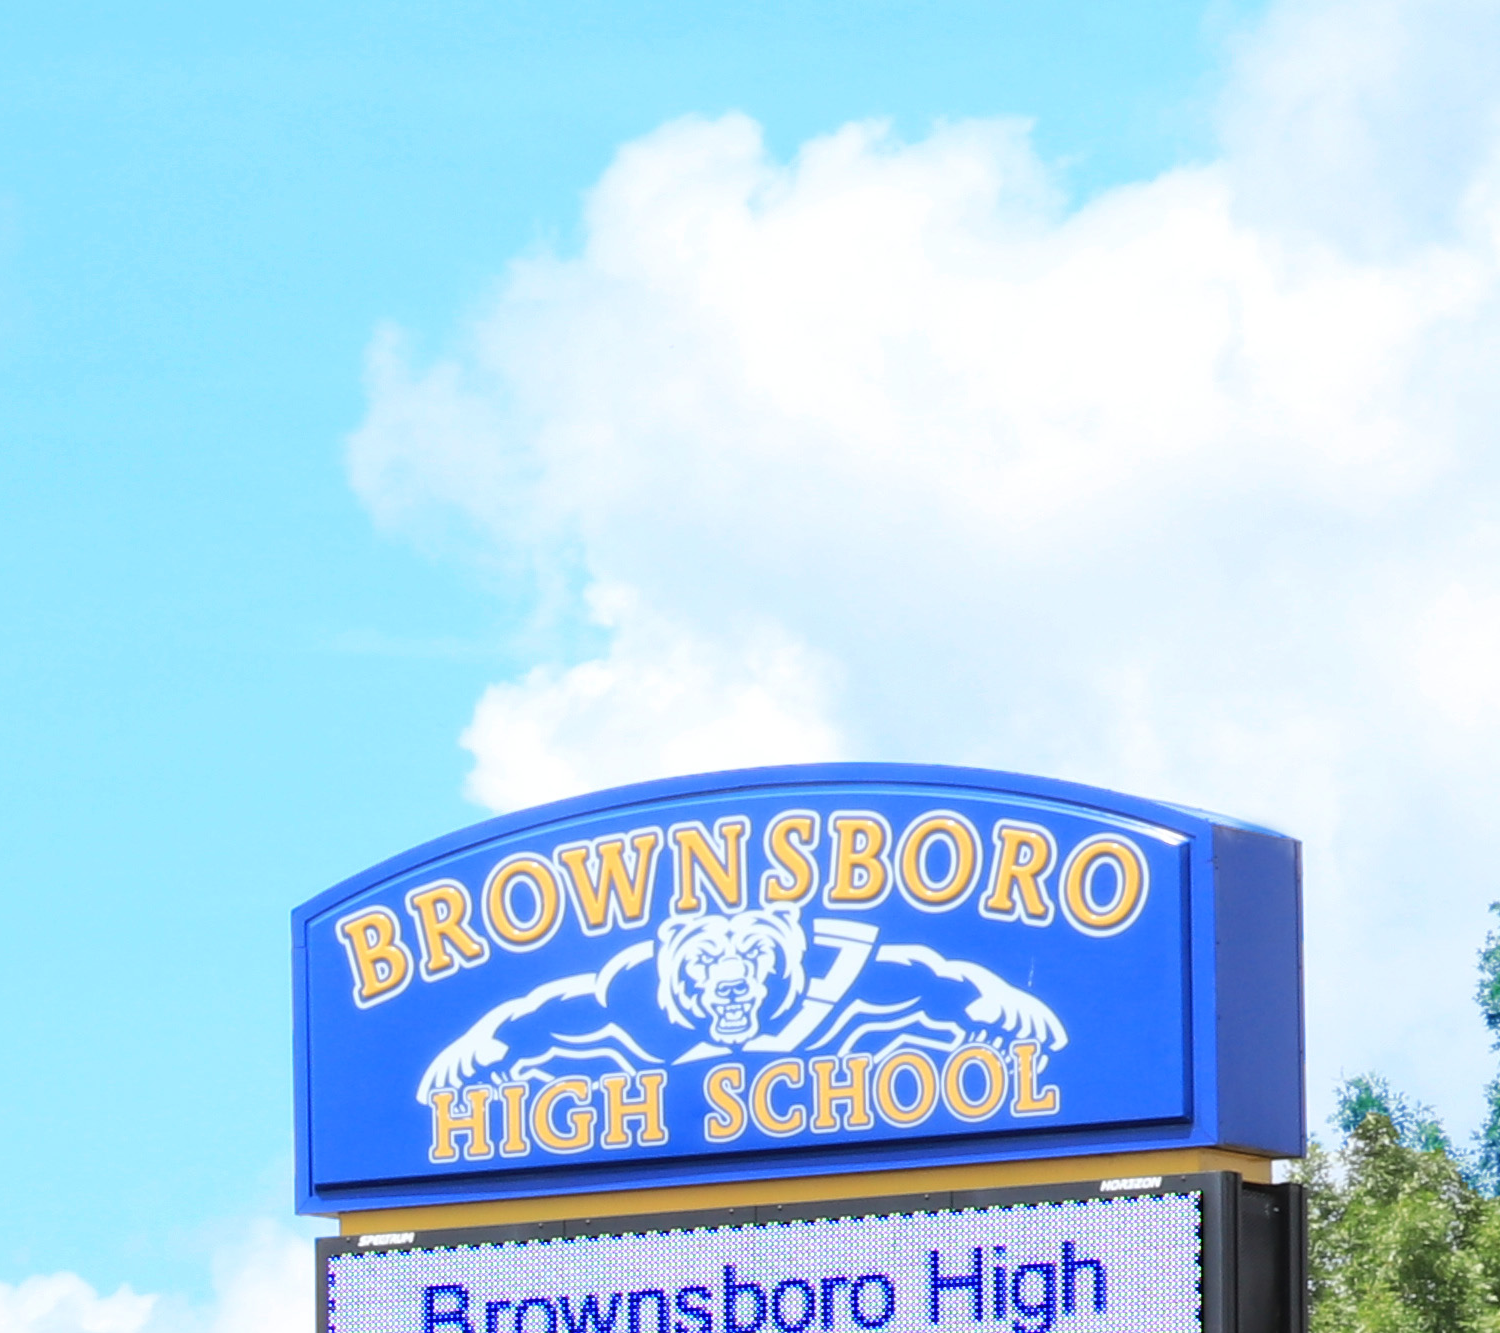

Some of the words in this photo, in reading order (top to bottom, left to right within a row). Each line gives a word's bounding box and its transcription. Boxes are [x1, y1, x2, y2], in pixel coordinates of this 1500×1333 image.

[336, 809, 1150, 1008] BROWNSBORO
[429, 1069, 668, 1163] HIGH
[704, 1038, 1060, 1142] SCHOOL
[1100, 1176, 1162, 1192] HORIZON
